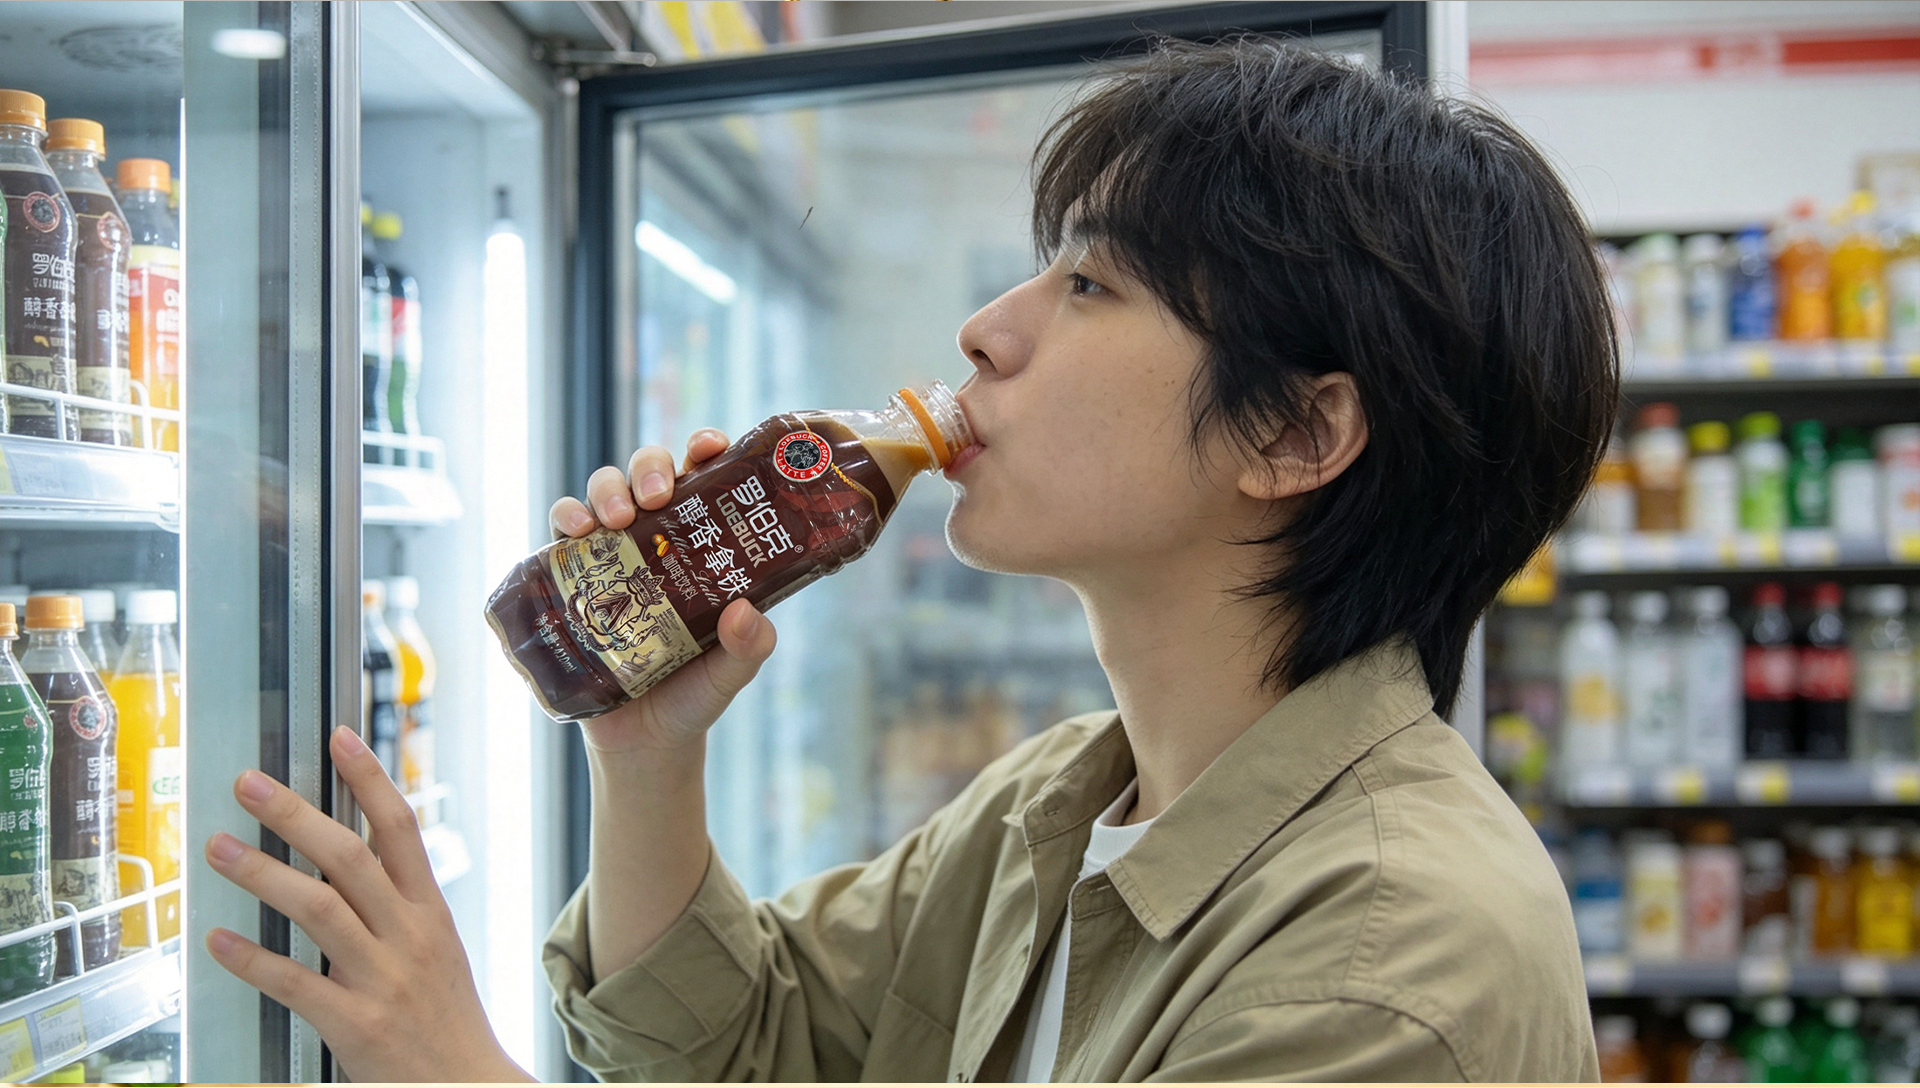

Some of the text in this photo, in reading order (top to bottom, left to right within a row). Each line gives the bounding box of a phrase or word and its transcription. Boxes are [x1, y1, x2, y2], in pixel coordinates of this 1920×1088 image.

[777, 457, 806, 479] LATTE
[778, 433, 829, 471] LOEBUCK COFFEE
[674, 493, 753, 600] 醇香拿铁
[715, 492, 768, 568] LOEBUCK
[731, 475, 794, 559] 罗伯克
[661, 553, 699, 601] 咖啡饮料
